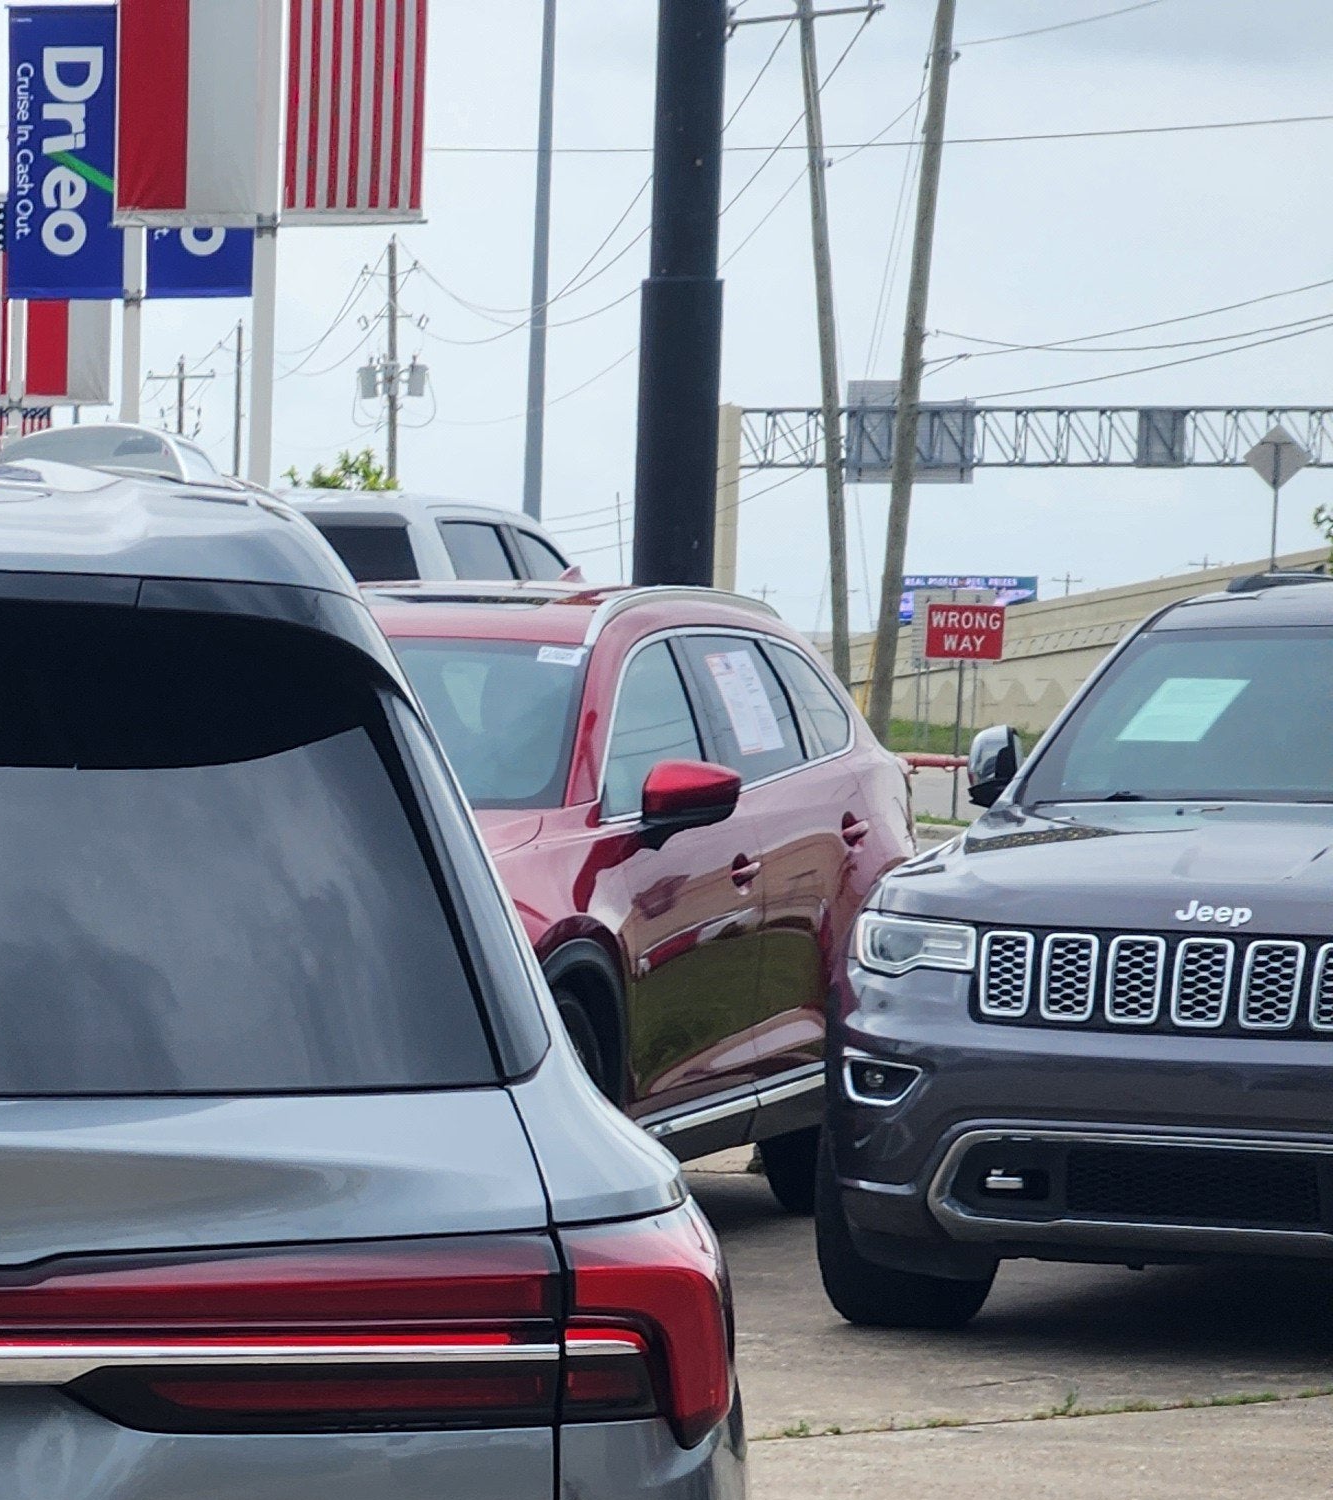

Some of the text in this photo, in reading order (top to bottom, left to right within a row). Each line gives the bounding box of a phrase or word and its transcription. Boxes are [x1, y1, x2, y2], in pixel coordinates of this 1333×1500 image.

[16, 62, 34, 122] Cruise
[16, 149, 34, 196] Cash
[15, 199, 33, 240] Out.
[932, 611, 1002, 630] WRONG
[944, 634, 986, 652] WAY
[1175, 900, 1252, 928] Jeep
